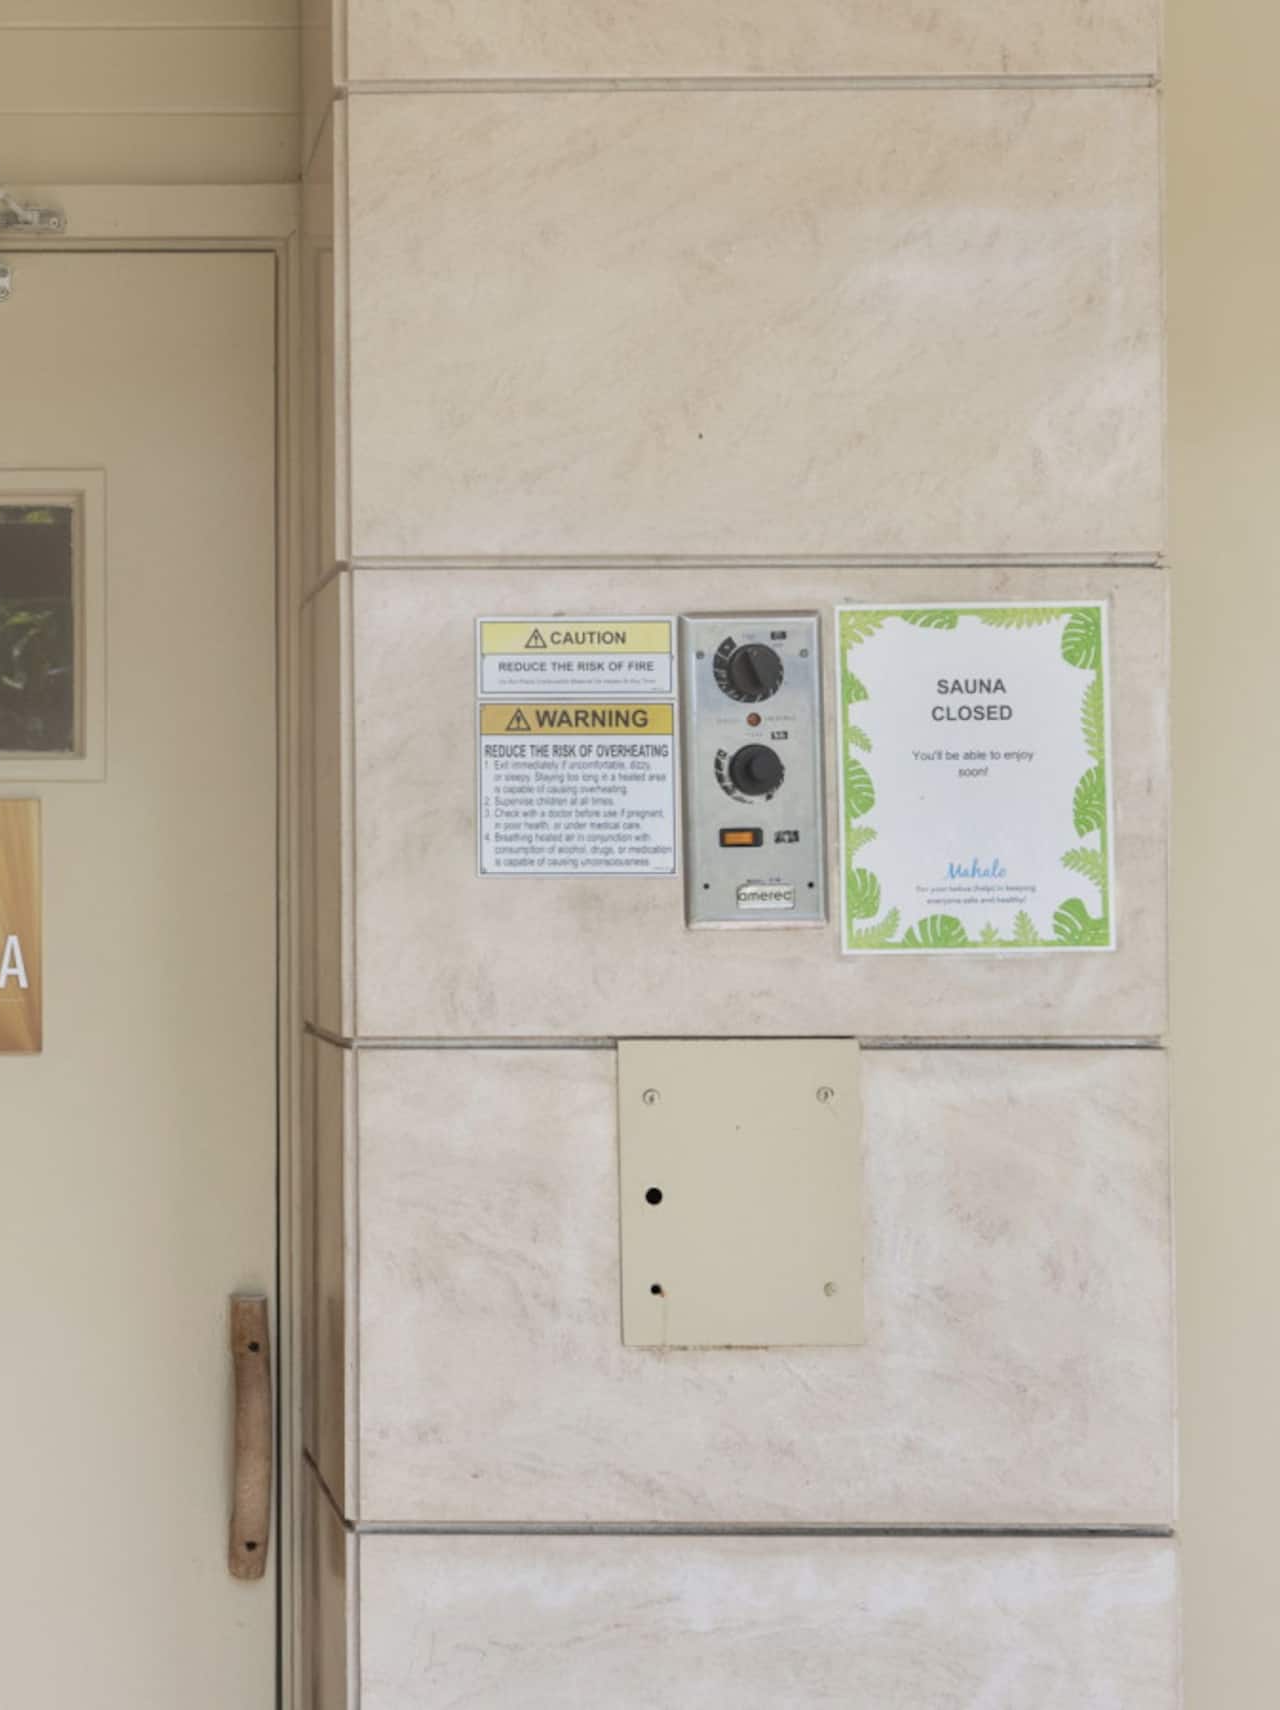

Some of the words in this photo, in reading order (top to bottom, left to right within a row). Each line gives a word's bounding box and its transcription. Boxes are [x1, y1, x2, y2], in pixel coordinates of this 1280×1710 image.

[550, 631, 627, 645] CAUTION
[498, 661, 547, 672] REDUCE
[551, 661, 574, 672] THE
[577, 661, 605, 672] RISK
[608, 661, 624, 672] OF
[627, 661, 655, 672] FIRE
[936, 678, 1007, 695] SAUNA
[535, 709, 649, 728] WARNING
[931, 705, 1013, 721] CLOSED
[484, 744, 527, 757] REDUCE
[530, 744, 550, 757] THE
[552, 744, 577, 757] RISK
[579, 744, 593, 757] OF
[596, 744, 669, 757] OVERHEATING
[911, 750, 943, 760] You'll
[945, 750, 960, 760] be
[962, 750, 987, 760] able
[990, 750, 1001, 760] to
[1003, 751, 1034, 763] enjoy
[958, 766, 989, 777] soon!
[737, 891, 792, 901] amerec
